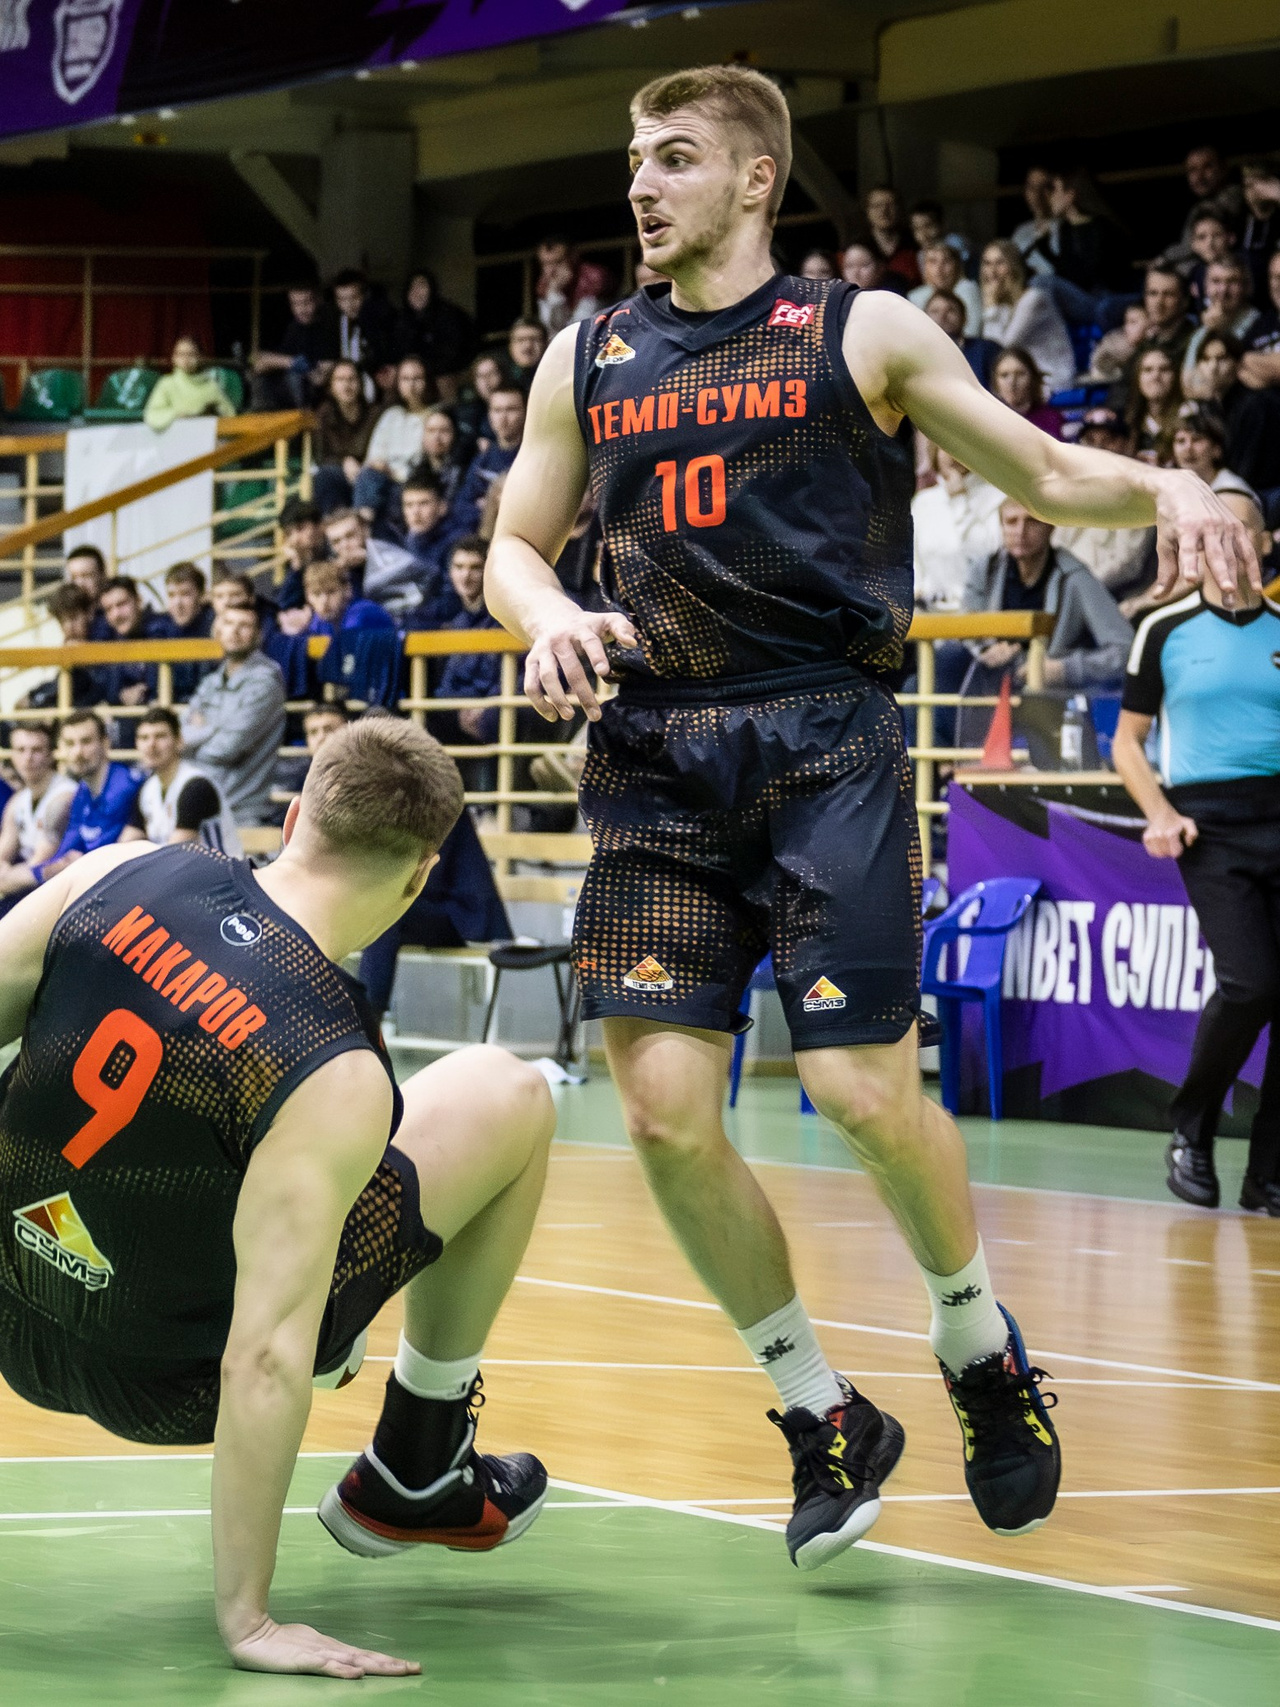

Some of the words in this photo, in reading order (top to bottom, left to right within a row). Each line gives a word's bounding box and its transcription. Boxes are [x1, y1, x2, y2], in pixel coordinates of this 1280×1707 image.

[588, 379, 807, 444] ТЕМП-СУМЗ
[655, 454, 727, 532] 10
[226, 917, 256, 942] РФБ
[101, 905, 268, 1051] МАКАРОВ
[804, 999, 845, 1011] СУМЗ
[61, 1008, 164, 1170] 9
[15, 1222, 109, 1290] СУМЗ
